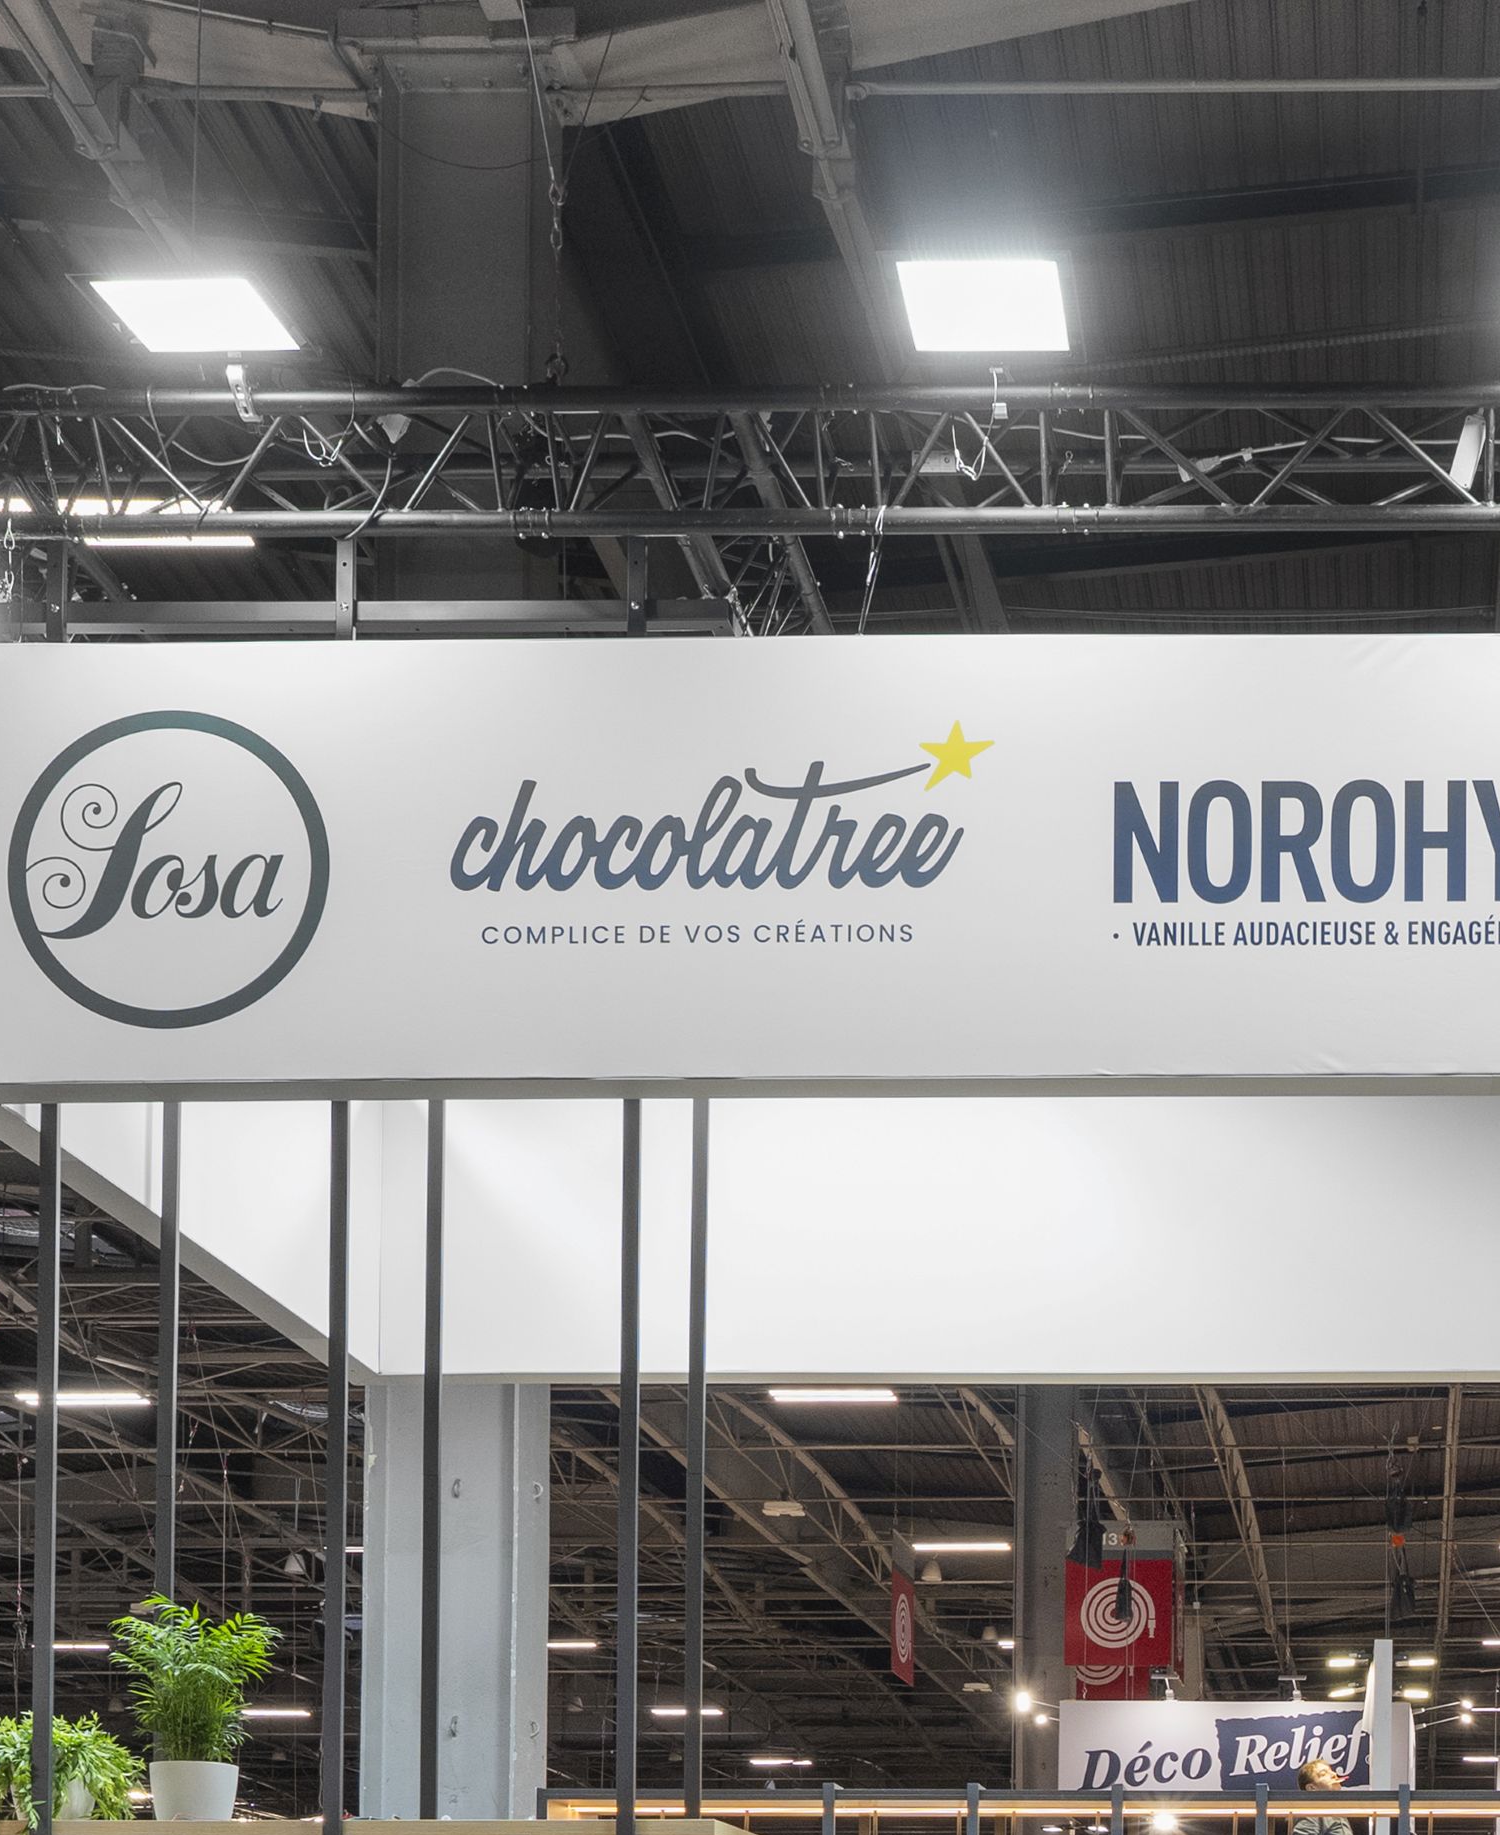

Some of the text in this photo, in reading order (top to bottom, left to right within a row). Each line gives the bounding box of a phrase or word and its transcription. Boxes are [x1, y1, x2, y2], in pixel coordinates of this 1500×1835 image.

[24, 780, 284, 940] Sosa
[450, 760, 965, 892] chocolatree
[481, 919, 914, 945] COMPLICE DE VOS CRÉATIONS
[1132, 921, 1226, 946] VANILLE
[1233, 921, 1376, 946] AUDACIEUSE
[1384, 921, 1399, 945] &
[1077, 1720, 1367, 1791] Déco Relief
